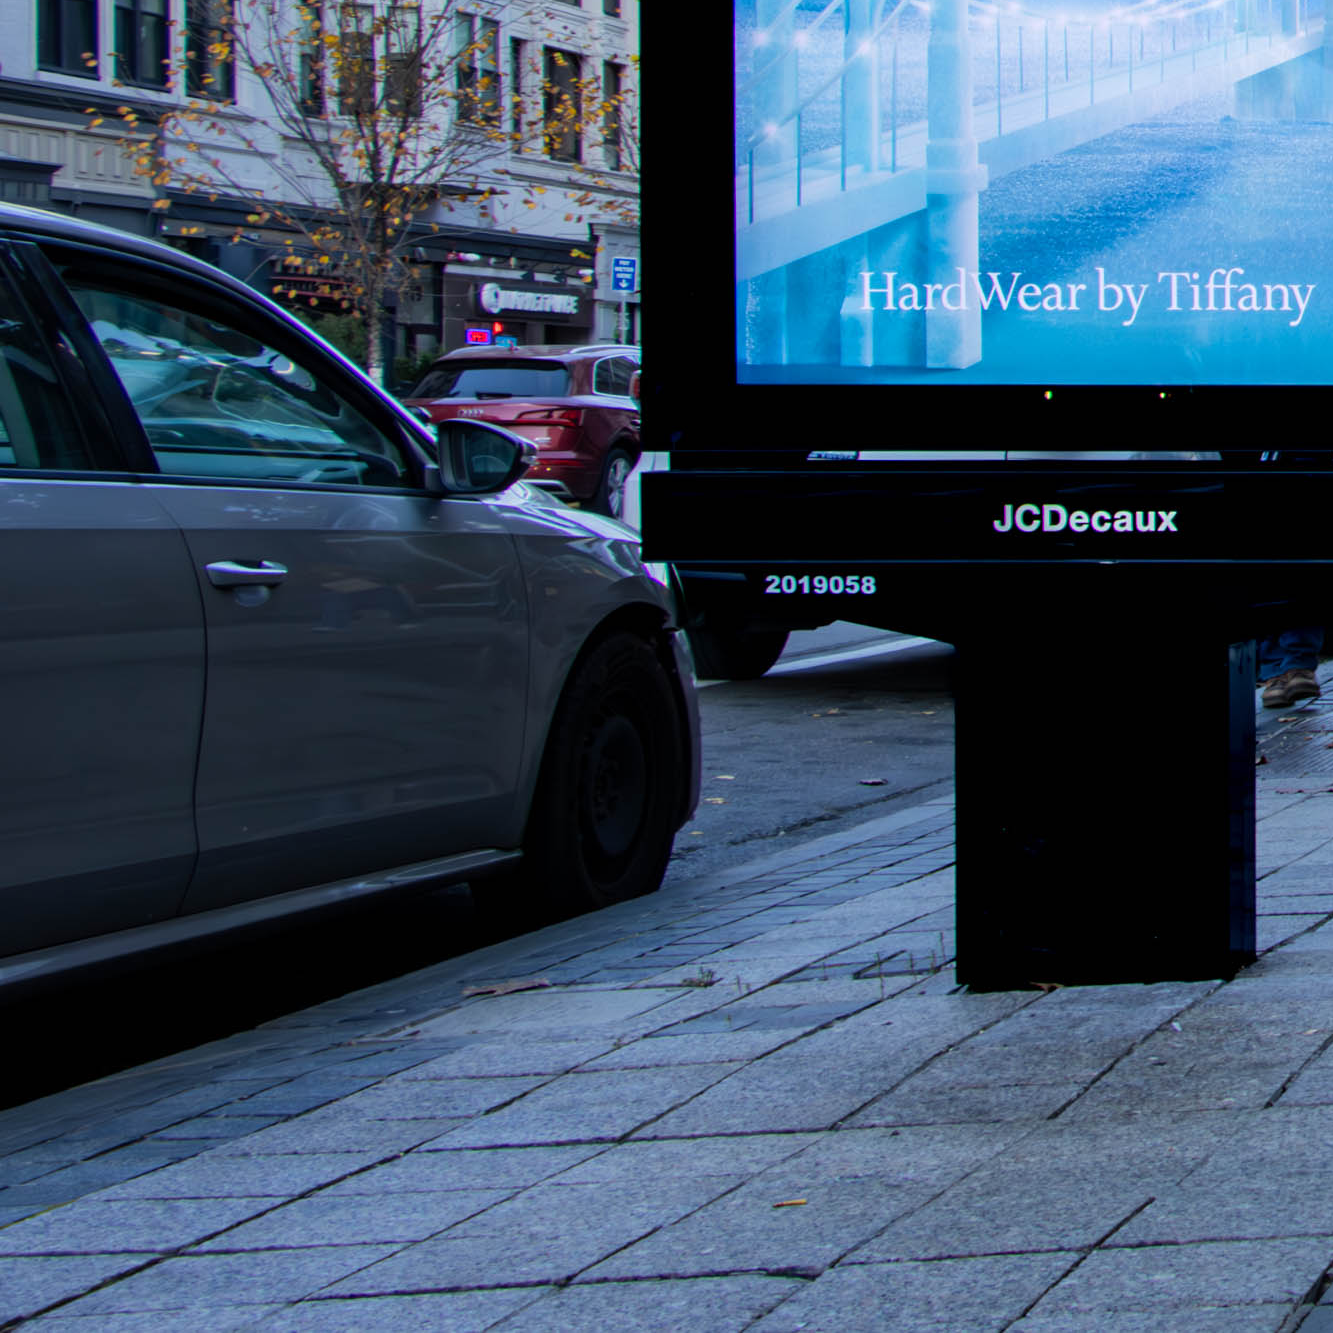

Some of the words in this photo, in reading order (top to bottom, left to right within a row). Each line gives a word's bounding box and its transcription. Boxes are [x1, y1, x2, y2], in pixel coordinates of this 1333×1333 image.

[858, 268, 1086, 312] HardWear
[1095, 266, 1148, 327] by
[1158, 266, 1316, 327] Tiffany
[993, 502, 1178, 533] JCDecaux
[765, 574, 875, 595] 2019058
